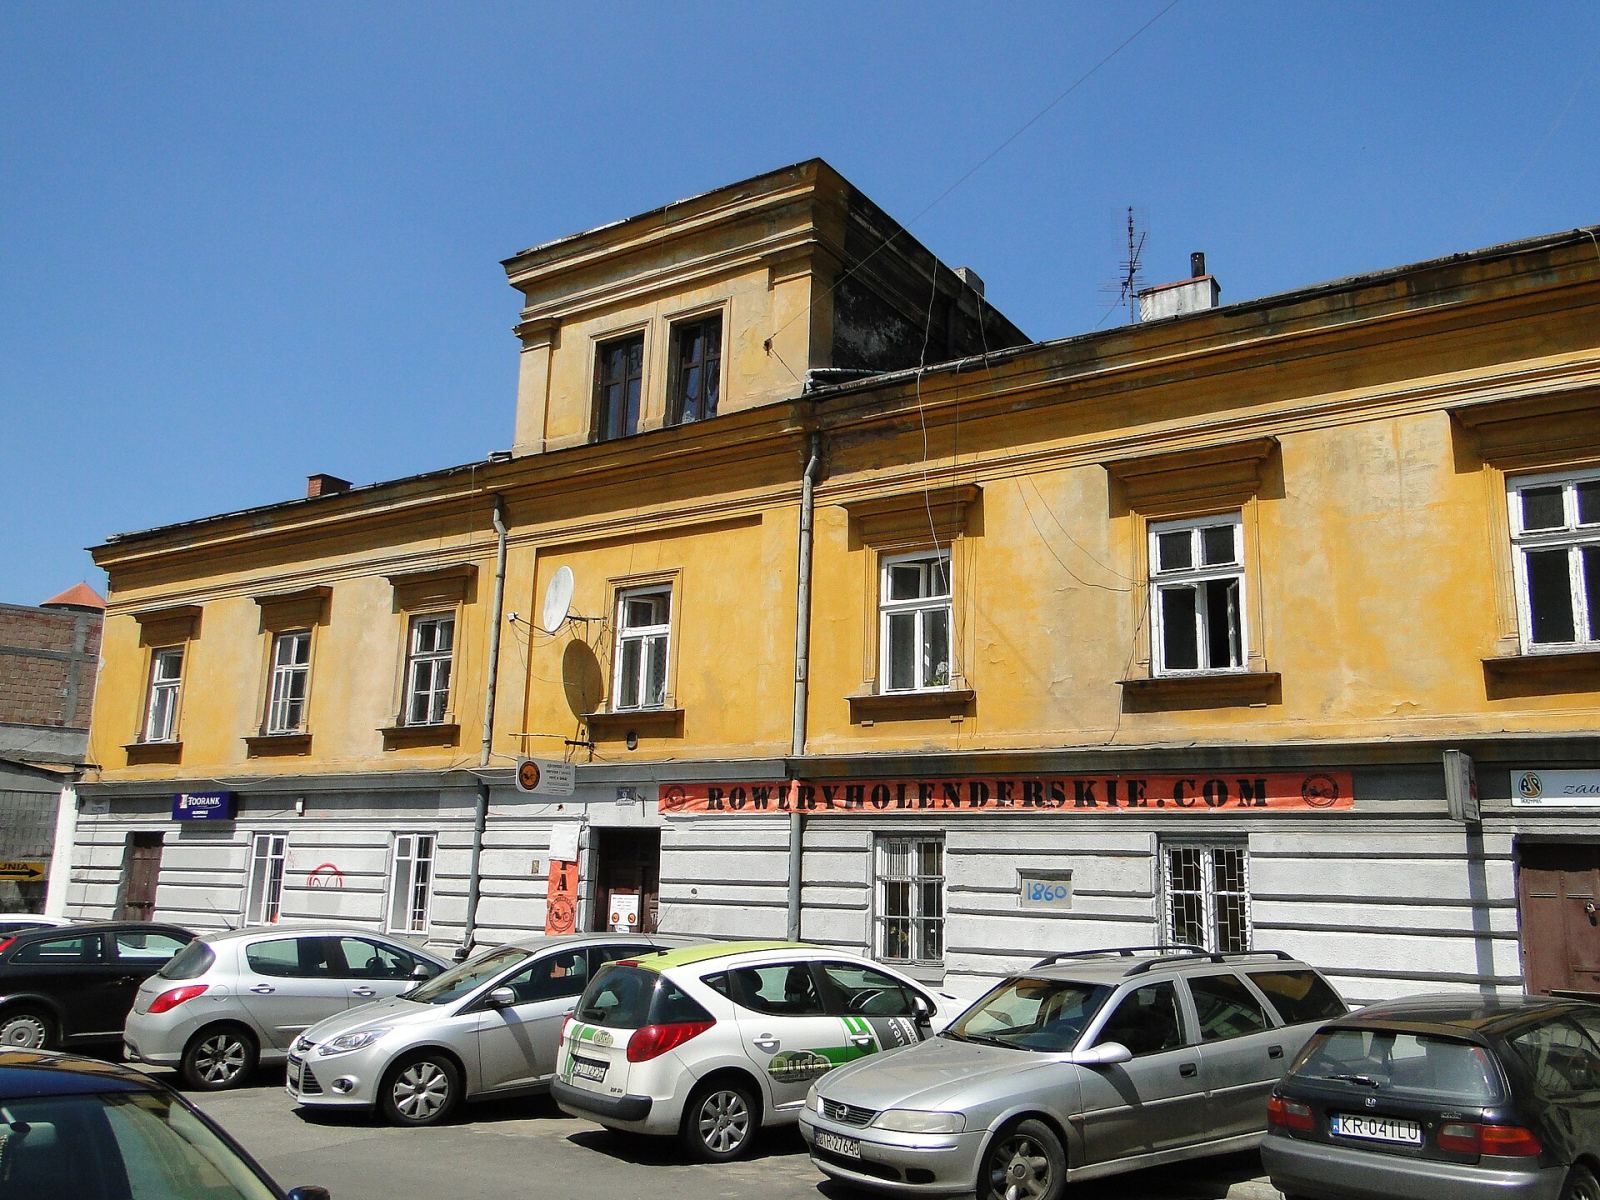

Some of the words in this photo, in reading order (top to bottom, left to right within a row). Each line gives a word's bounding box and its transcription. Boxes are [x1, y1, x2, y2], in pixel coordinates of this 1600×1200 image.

[188, 796, 220, 806] TOORANK
[1028, 882, 1067, 901] 1860
[1342, 1116, 1363, 1134] KR
[1369, 1119, 1418, 1140] 041LU
